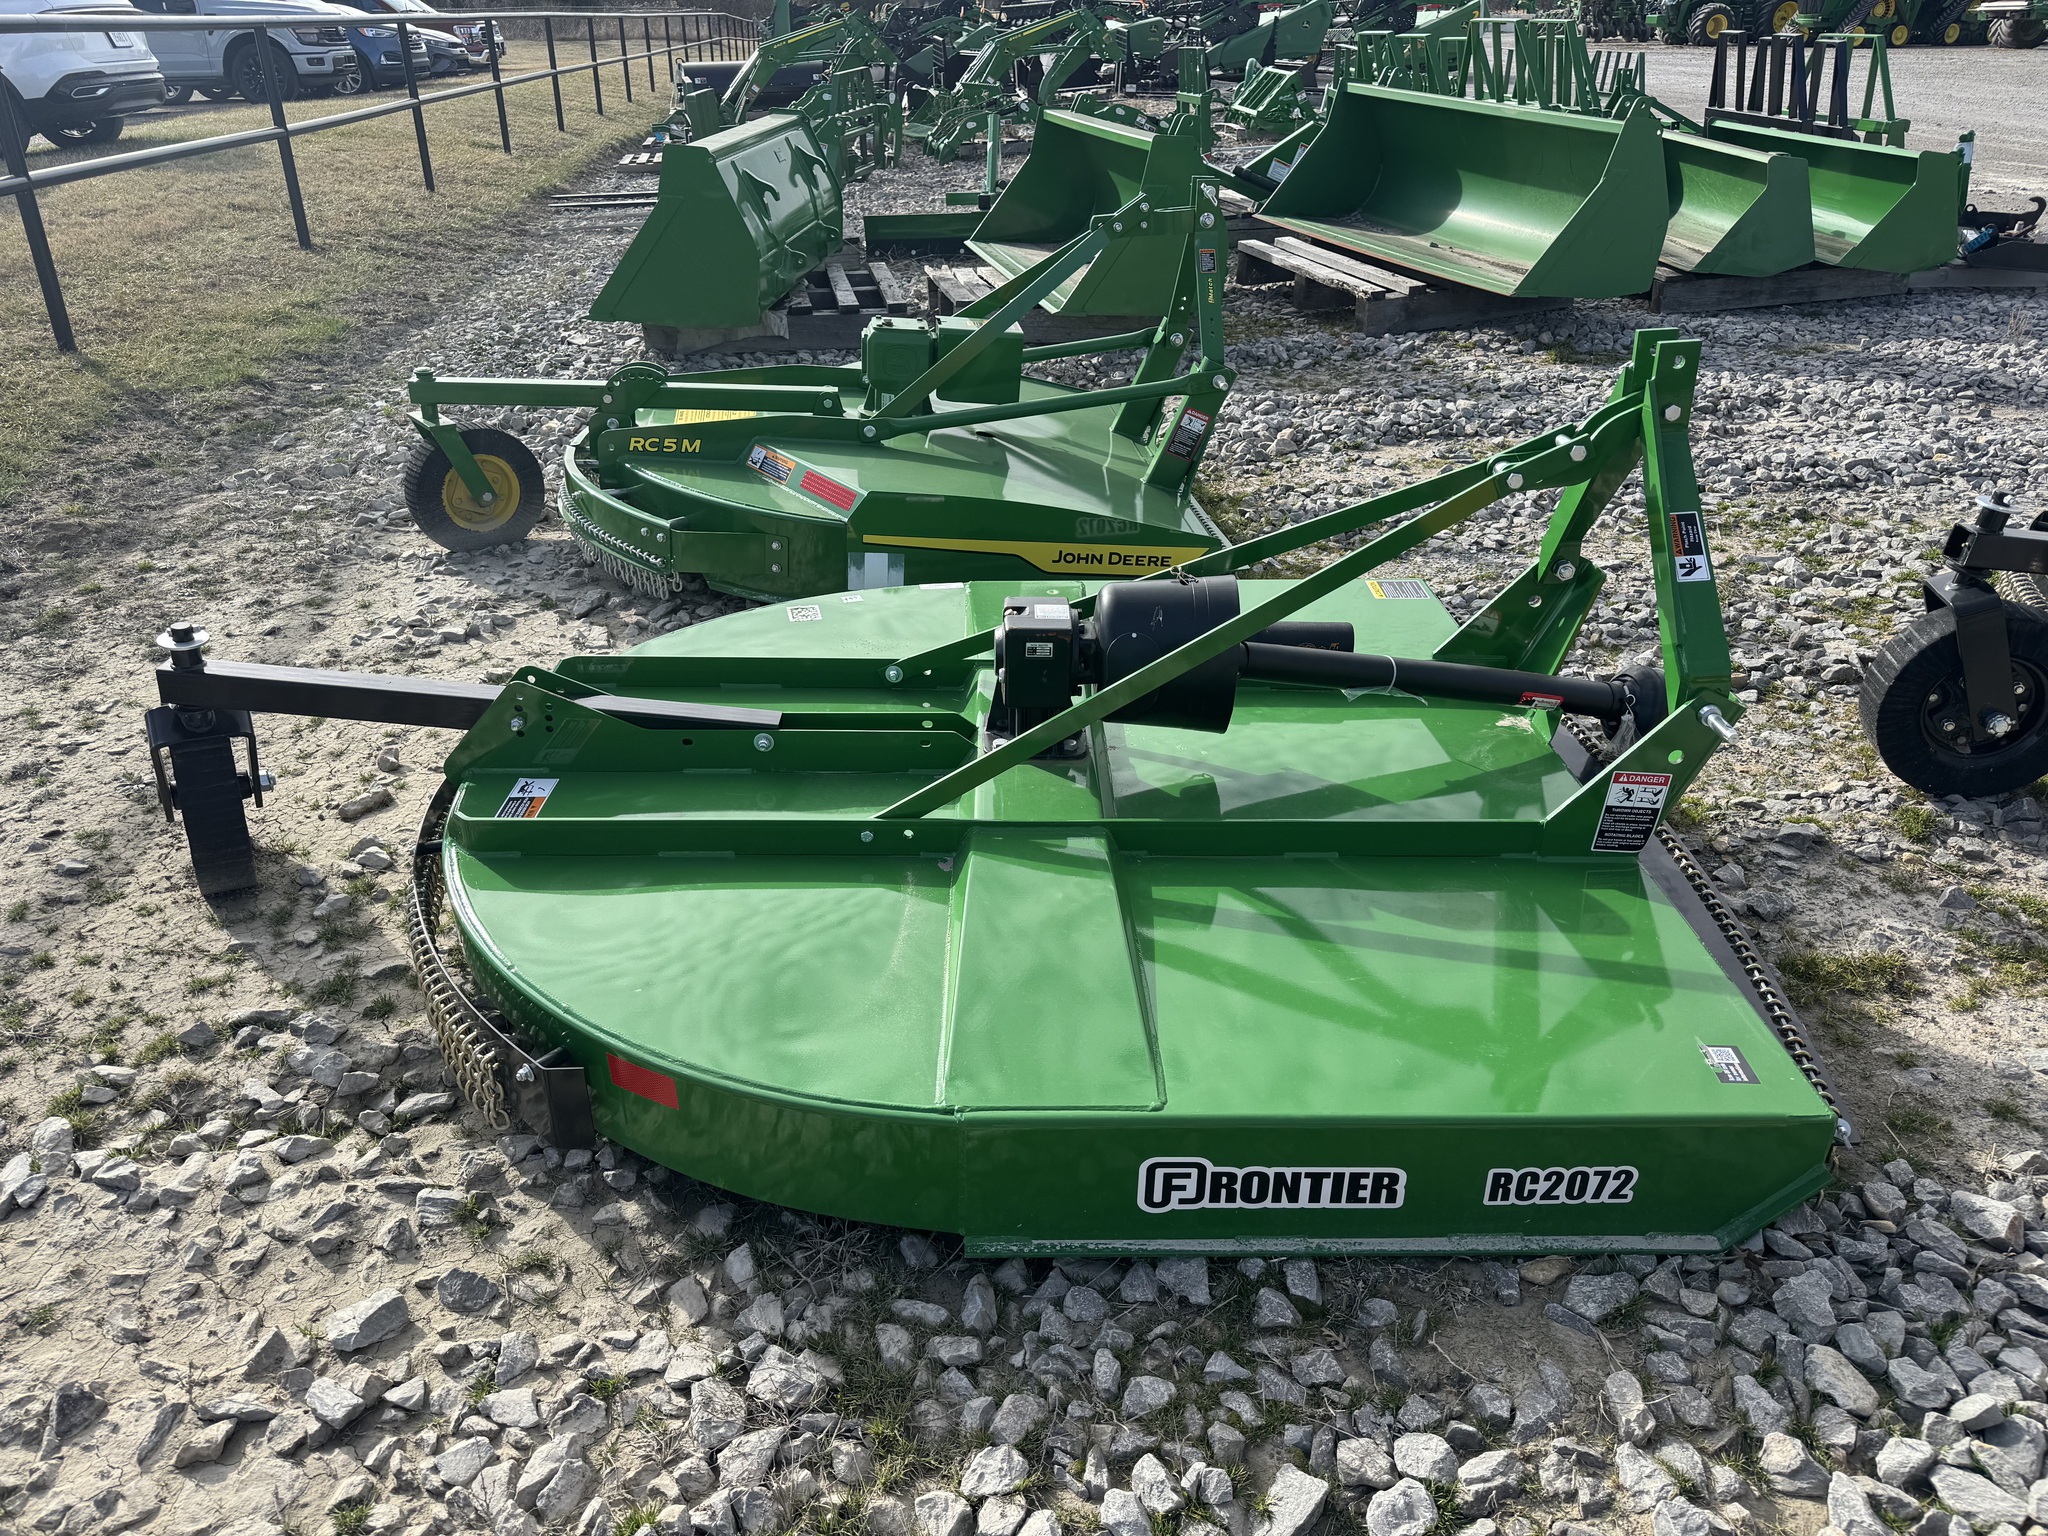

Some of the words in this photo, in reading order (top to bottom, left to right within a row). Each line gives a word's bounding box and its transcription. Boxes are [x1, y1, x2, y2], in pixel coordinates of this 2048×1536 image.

[1670, 516, 1682, 550] WARNING
[1051, 549, 1104, 565] JOHN
[1108, 551, 1172, 567] DEERE
[1628, 775, 1665, 784] DANGER
[1142, 1160, 1403, 1209] FRONTIER
[1487, 1168, 1635, 1202] RC2072
